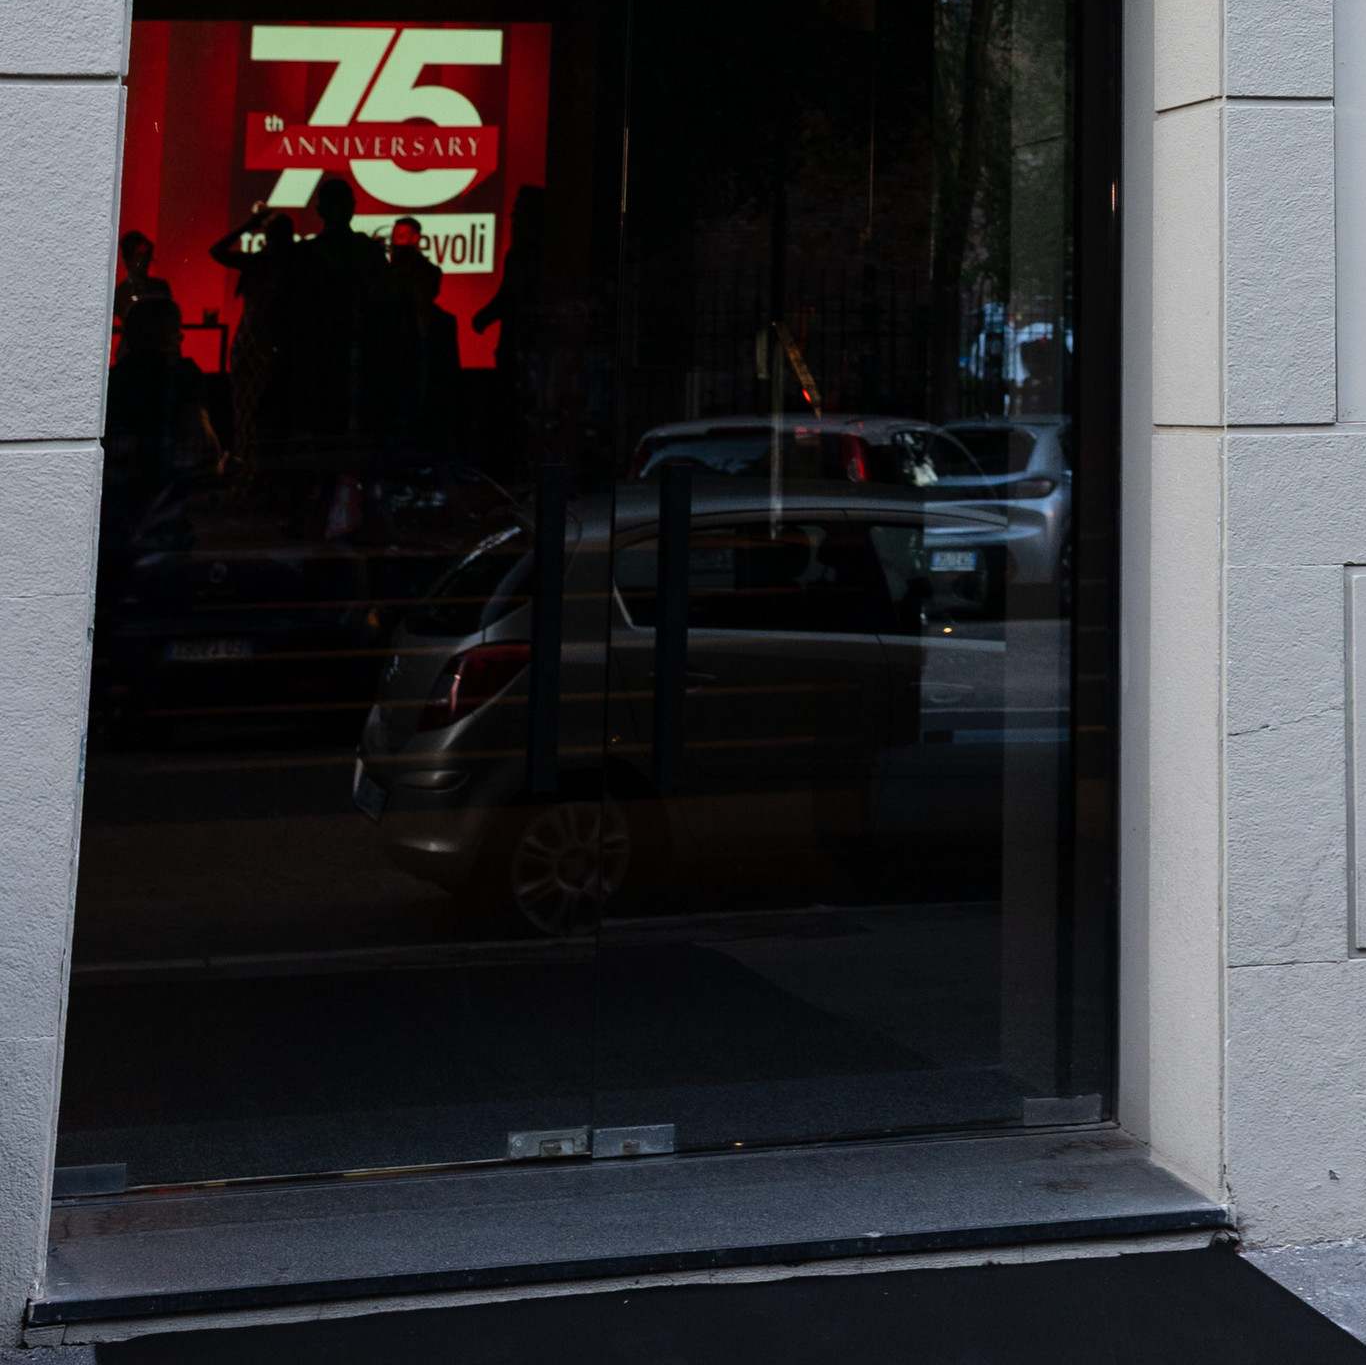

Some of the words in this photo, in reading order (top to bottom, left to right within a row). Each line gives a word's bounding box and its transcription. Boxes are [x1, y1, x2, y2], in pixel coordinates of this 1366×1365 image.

[251, 25, 503, 208] 75
[264, 115, 284, 132] th
[278, 136, 480, 157] ANNIVERSARY
[417, 222, 485, 264] evoli
